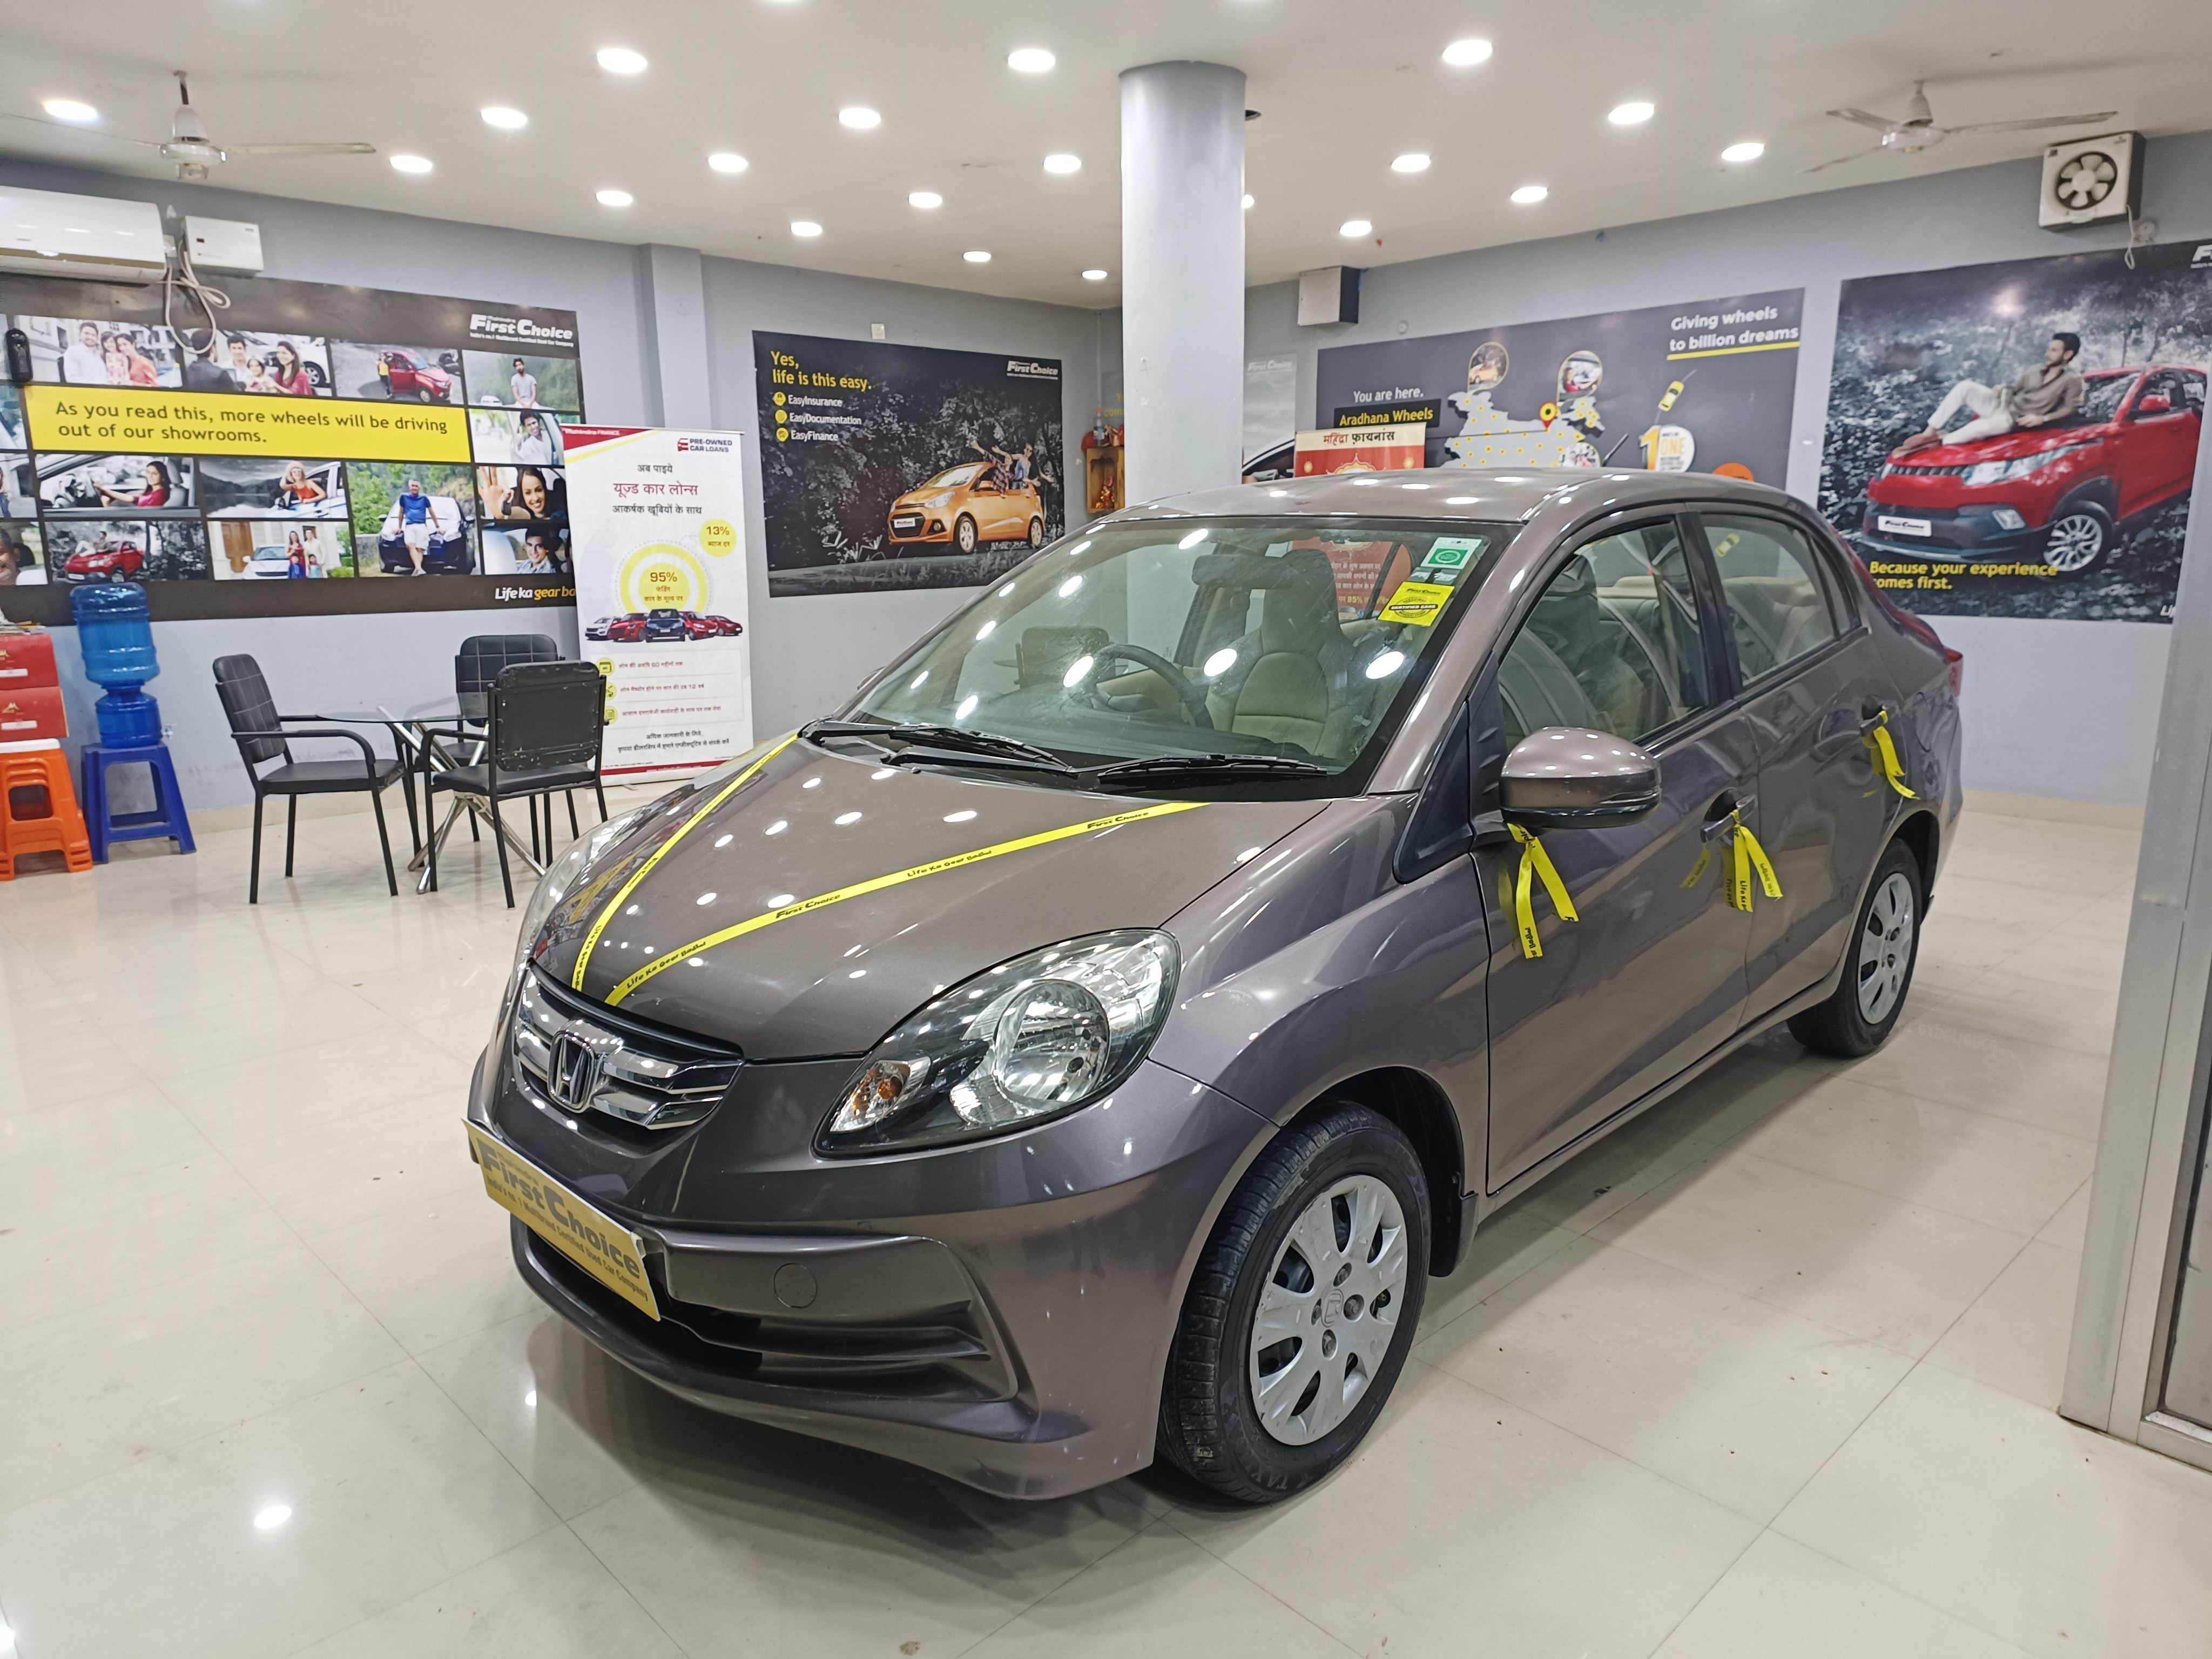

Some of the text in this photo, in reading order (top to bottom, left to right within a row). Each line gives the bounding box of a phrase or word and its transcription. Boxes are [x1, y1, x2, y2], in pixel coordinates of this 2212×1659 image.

[470, 314, 572, 339] First Choice
[1671, 306, 1778, 331] Giving wheels
[1670, 327, 1799, 351] to billion dreams
[770, 350, 799, 369] Yes,
[772, 369, 872, 392] life is this easy.
[788, 395, 843, 407] EasyInsurance
[1353, 387, 1424, 403] You are here.
[56, 401, 448, 434] As you read this, more wheels will be driving
[789, 413, 862, 425] EasyDocumentation
[1339, 407, 1433, 426] Aradhana Wheels
[58, 423, 267, 442] out of our showrooms.
[791, 430, 839, 442] EasyFinance
[1324, 433, 1348, 445] महिंद्रा
[637, 464, 651, 473] अब
[643, 484, 665, 495] कार
[669, 481, 698, 495] लोन्स
[612, 503, 645, 513] आकर्षक
[675, 503, 683, 514] के
[706, 526, 730, 535] 13%
[650, 572, 677, 582] 95%
[1870, 561, 2059, 577] Because your experience
[1873, 576, 1953, 590] omes first.
[495, 586, 576, 602] Life ka gear ba
[1087, 812, 1149, 829] First Choice
[944, 858, 964, 866] Gear
[775, 895, 840, 919] First Choice
[626, 954, 679, 989] Life Ka Gear
[476, 1138, 640, 1279] First Choice
